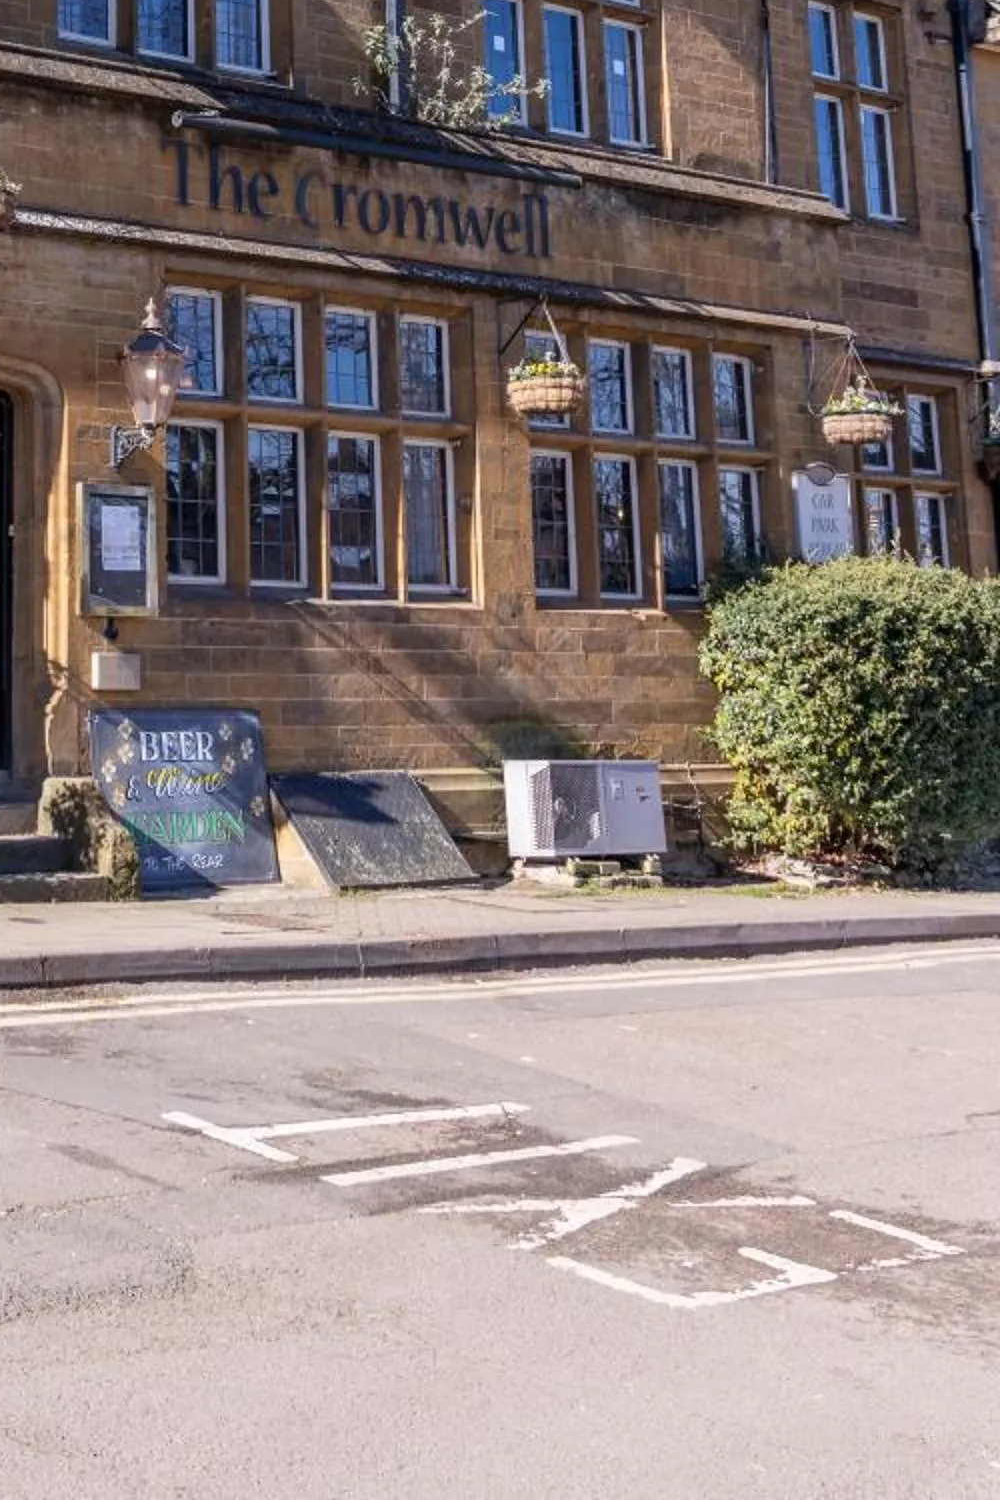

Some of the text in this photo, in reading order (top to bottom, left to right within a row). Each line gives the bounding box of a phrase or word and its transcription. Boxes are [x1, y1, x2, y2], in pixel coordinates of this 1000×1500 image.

[162, 136, 551, 258] The Cromwell
[811, 492, 835, 510] CAR
[811, 517, 840, 533] PARK
[139, 731, 214, 761] BEER
[126, 766, 227, 800] & Wine
